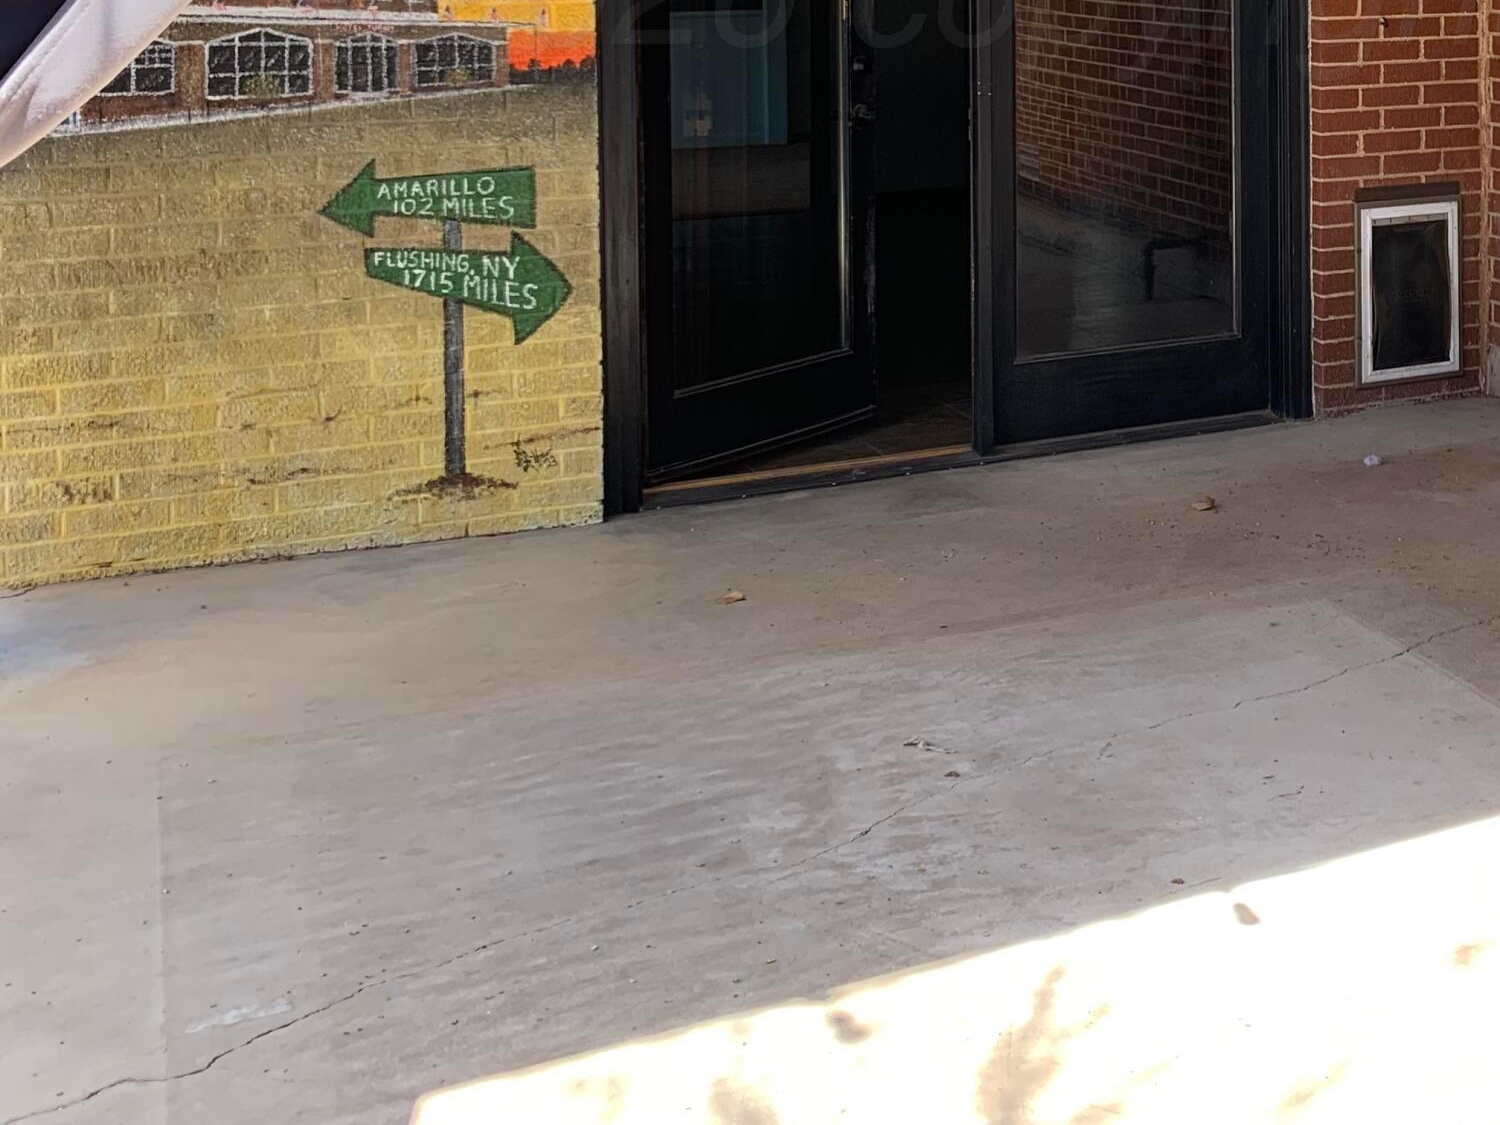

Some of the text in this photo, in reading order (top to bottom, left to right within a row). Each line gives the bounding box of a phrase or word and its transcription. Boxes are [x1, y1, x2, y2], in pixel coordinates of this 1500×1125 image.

[377, 176, 496, 200] AMARILLO
[393, 195, 514, 220] 102 MILES
[482, 255, 520, 280] NY
[403, 268, 539, 310] 1715 MILES
